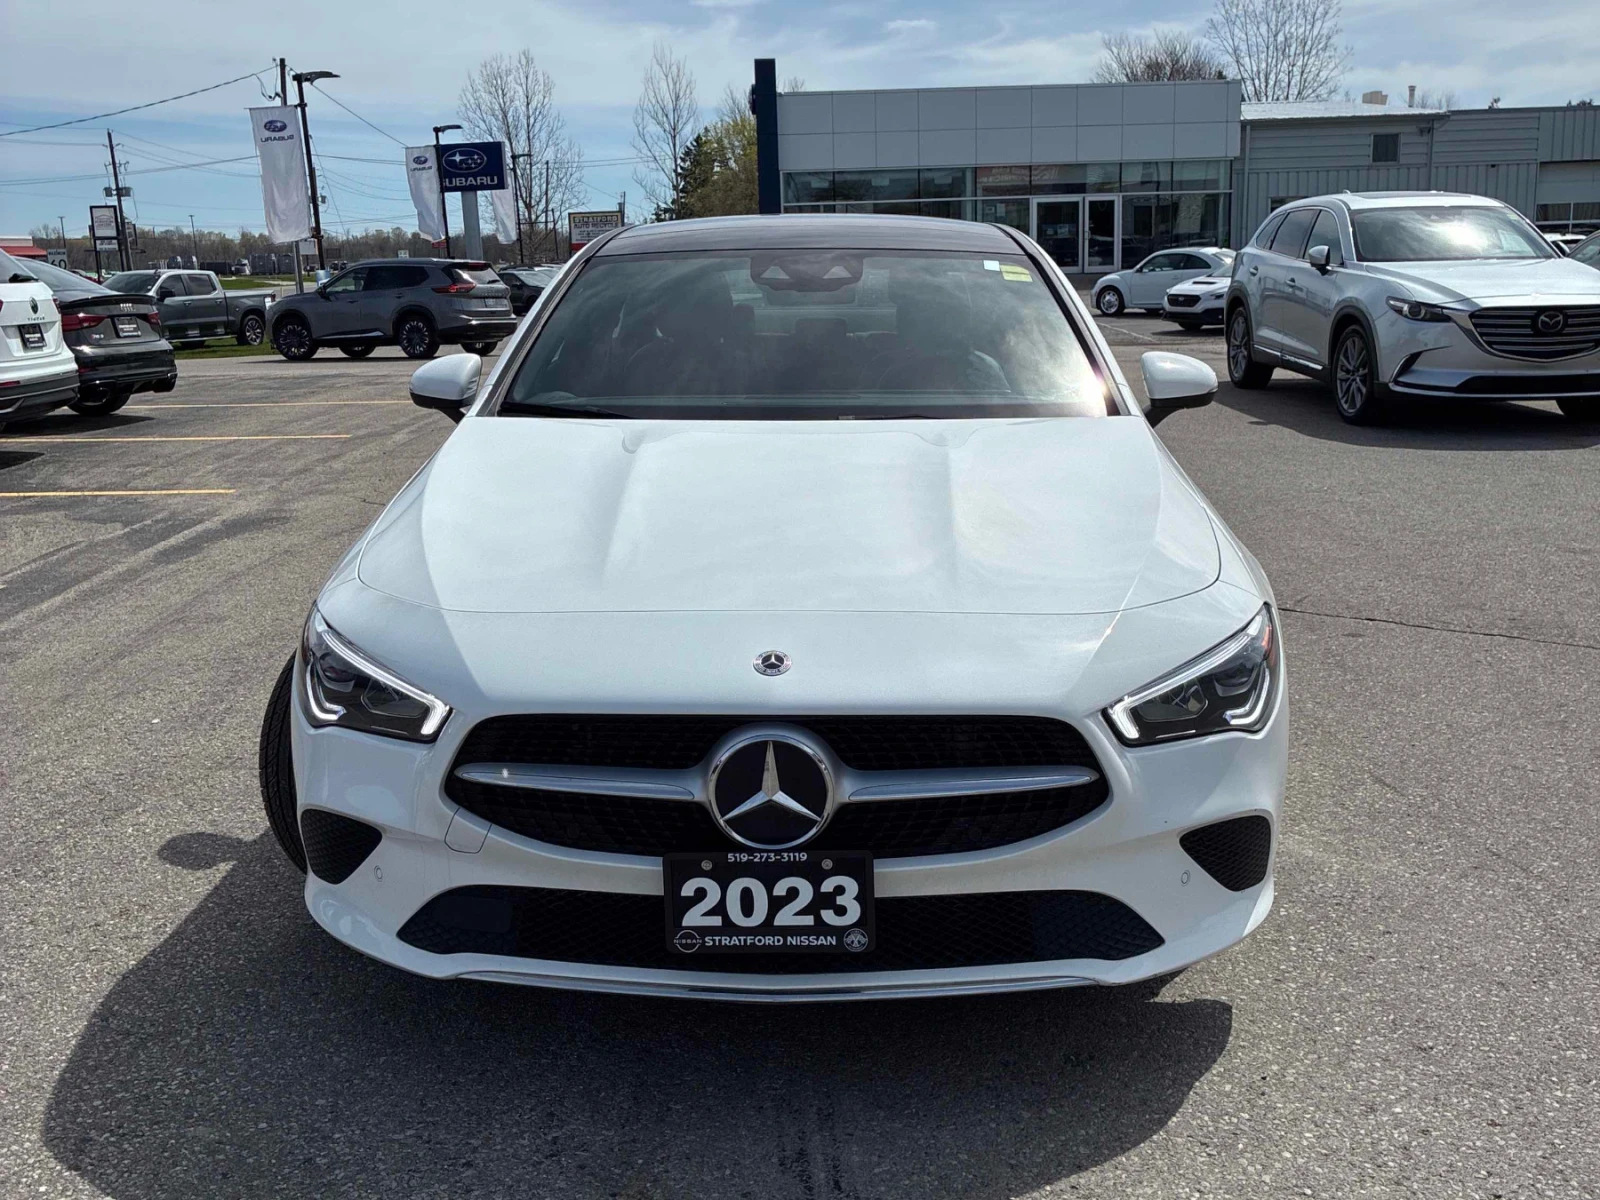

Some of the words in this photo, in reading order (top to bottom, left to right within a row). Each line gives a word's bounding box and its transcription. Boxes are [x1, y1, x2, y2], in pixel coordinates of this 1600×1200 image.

[727, 852, 808, 862] 519-273-3119
[680, 875, 862, 927] 2023
[704, 935, 784, 946] STRATFORD
[787, 935, 837, 946] NISSAN
